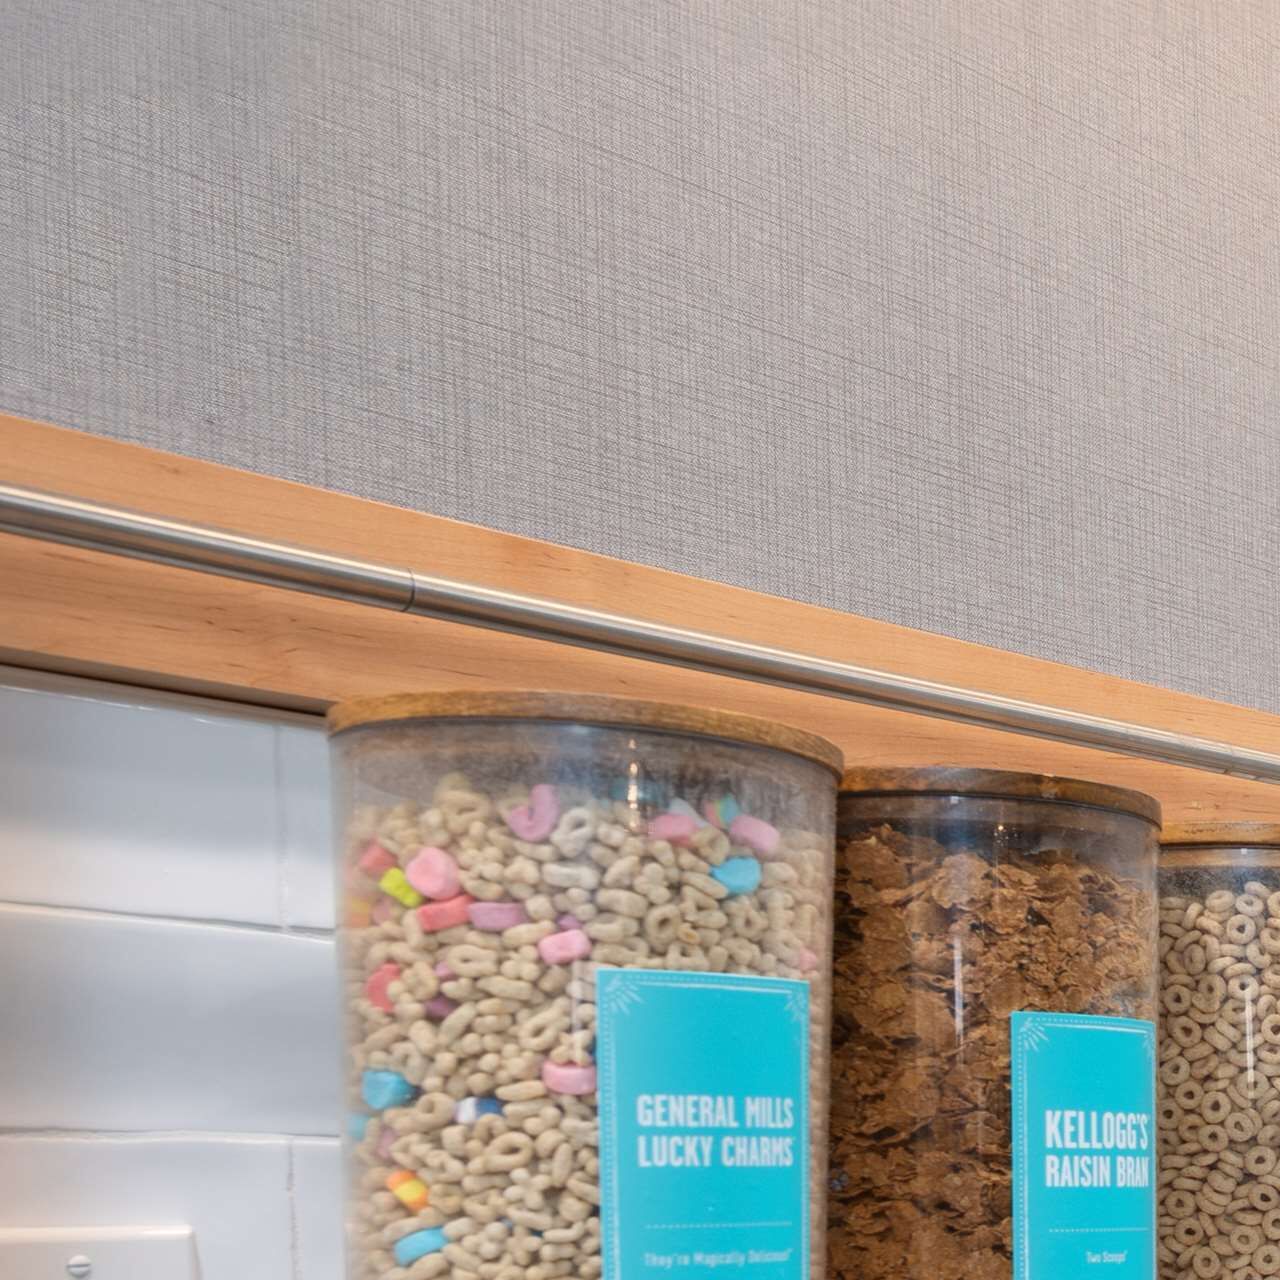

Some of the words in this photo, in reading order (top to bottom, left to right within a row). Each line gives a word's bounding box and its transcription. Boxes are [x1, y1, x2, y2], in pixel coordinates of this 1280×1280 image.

[637, 1094, 739, 1128] GENERAL
[744, 1096, 795, 1129] MILLS
[1045, 1109, 1149, 1151] KELLOGG'S
[637, 1135, 714, 1168] LUCKY
[720, 1136, 796, 1168] CHARMS
[1045, 1154, 1111, 1188] RAISIN
[1116, 1155, 1150, 1188] BRAN
